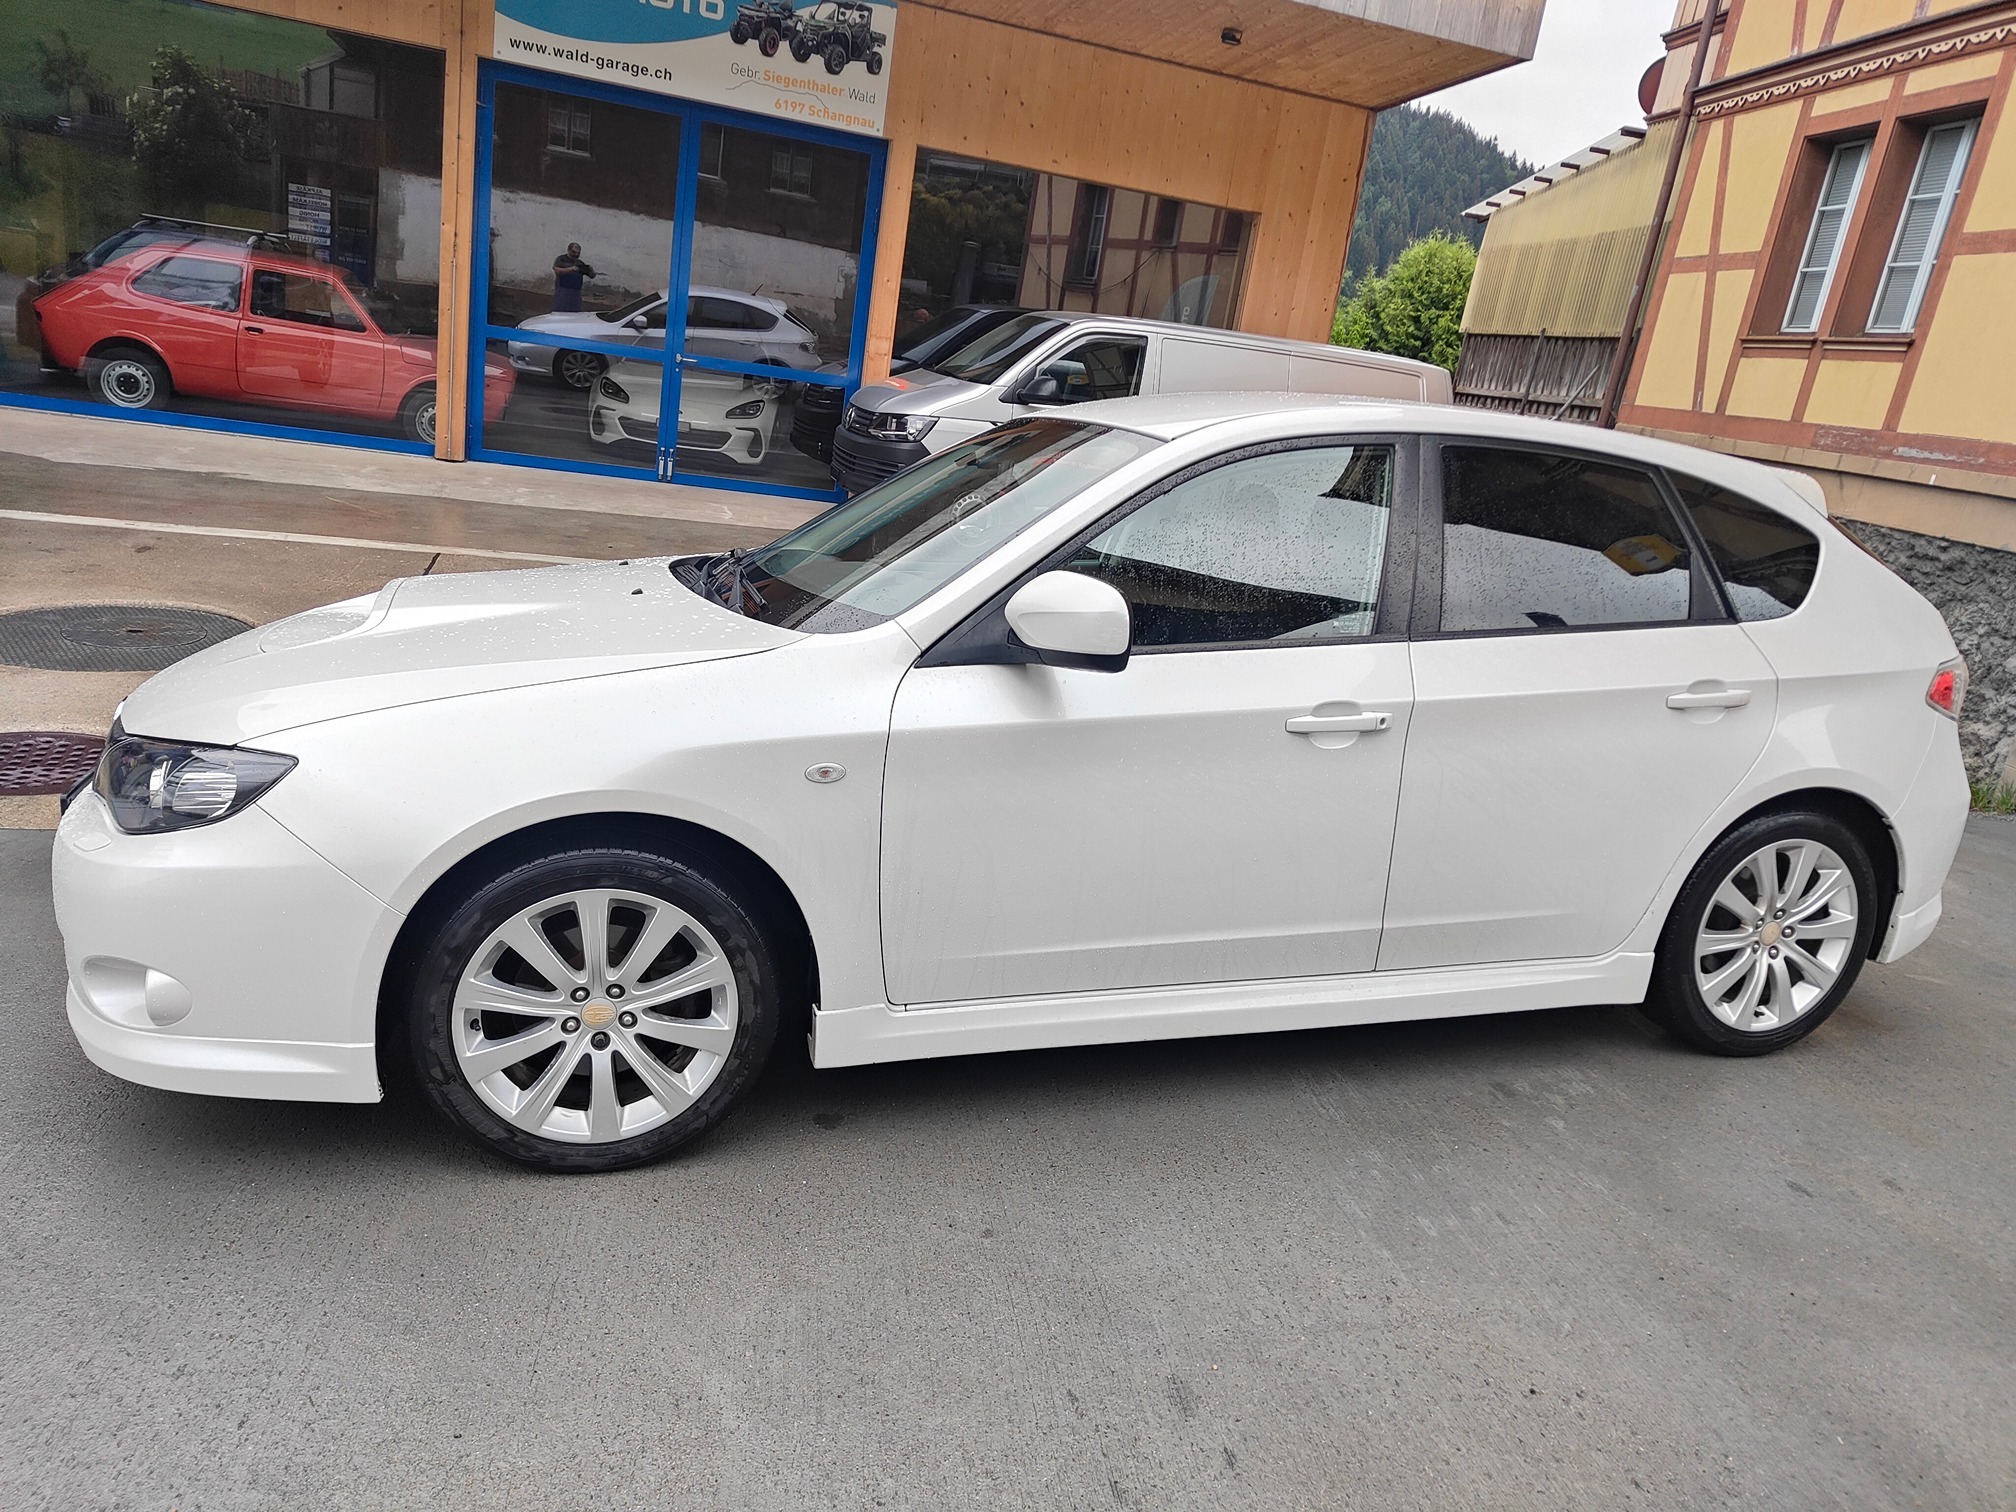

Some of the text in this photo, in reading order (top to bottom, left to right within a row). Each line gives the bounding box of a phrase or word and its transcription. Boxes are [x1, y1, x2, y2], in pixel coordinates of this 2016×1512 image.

[509, 37, 673, 81] www.wald-garage.ch
[730, 62, 876, 104] Gebr. Siegenthaler Wald
[774, 98, 875, 129] 6197 Schangnau
